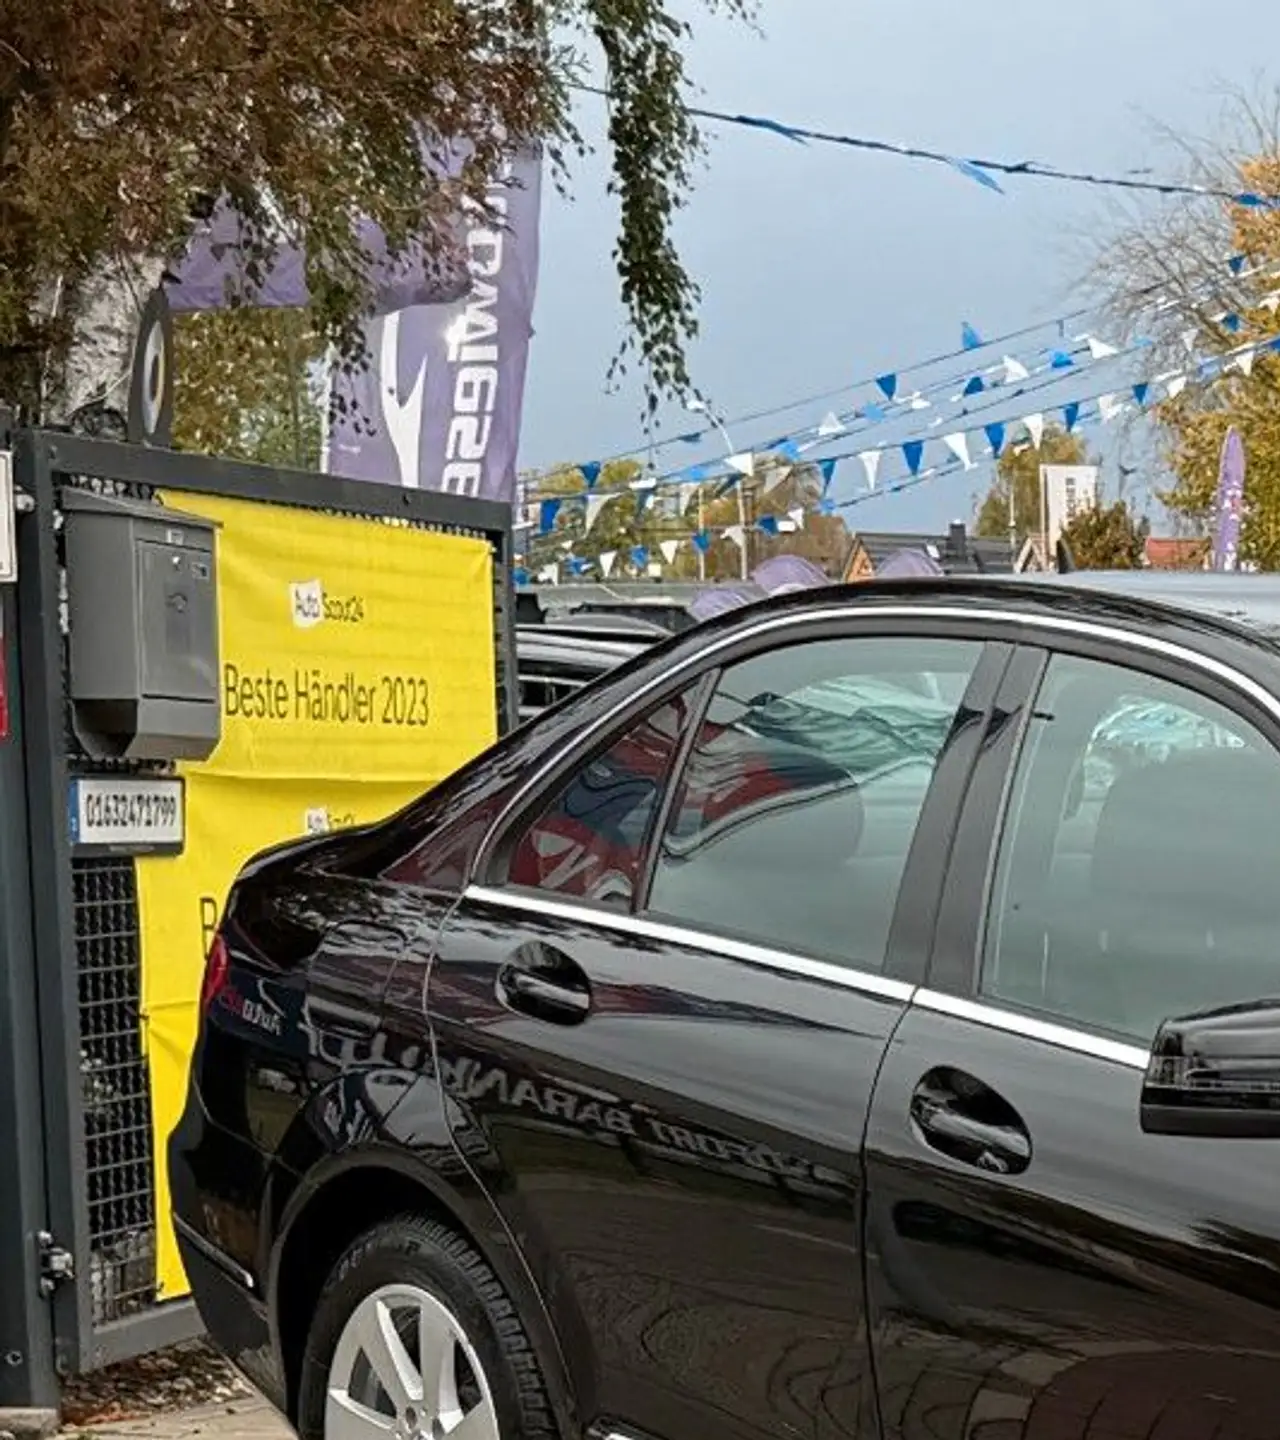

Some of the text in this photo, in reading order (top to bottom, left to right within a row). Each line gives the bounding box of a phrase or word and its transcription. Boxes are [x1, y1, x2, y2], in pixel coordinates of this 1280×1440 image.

[225, 663, 429, 726] Beste Händler 2023
